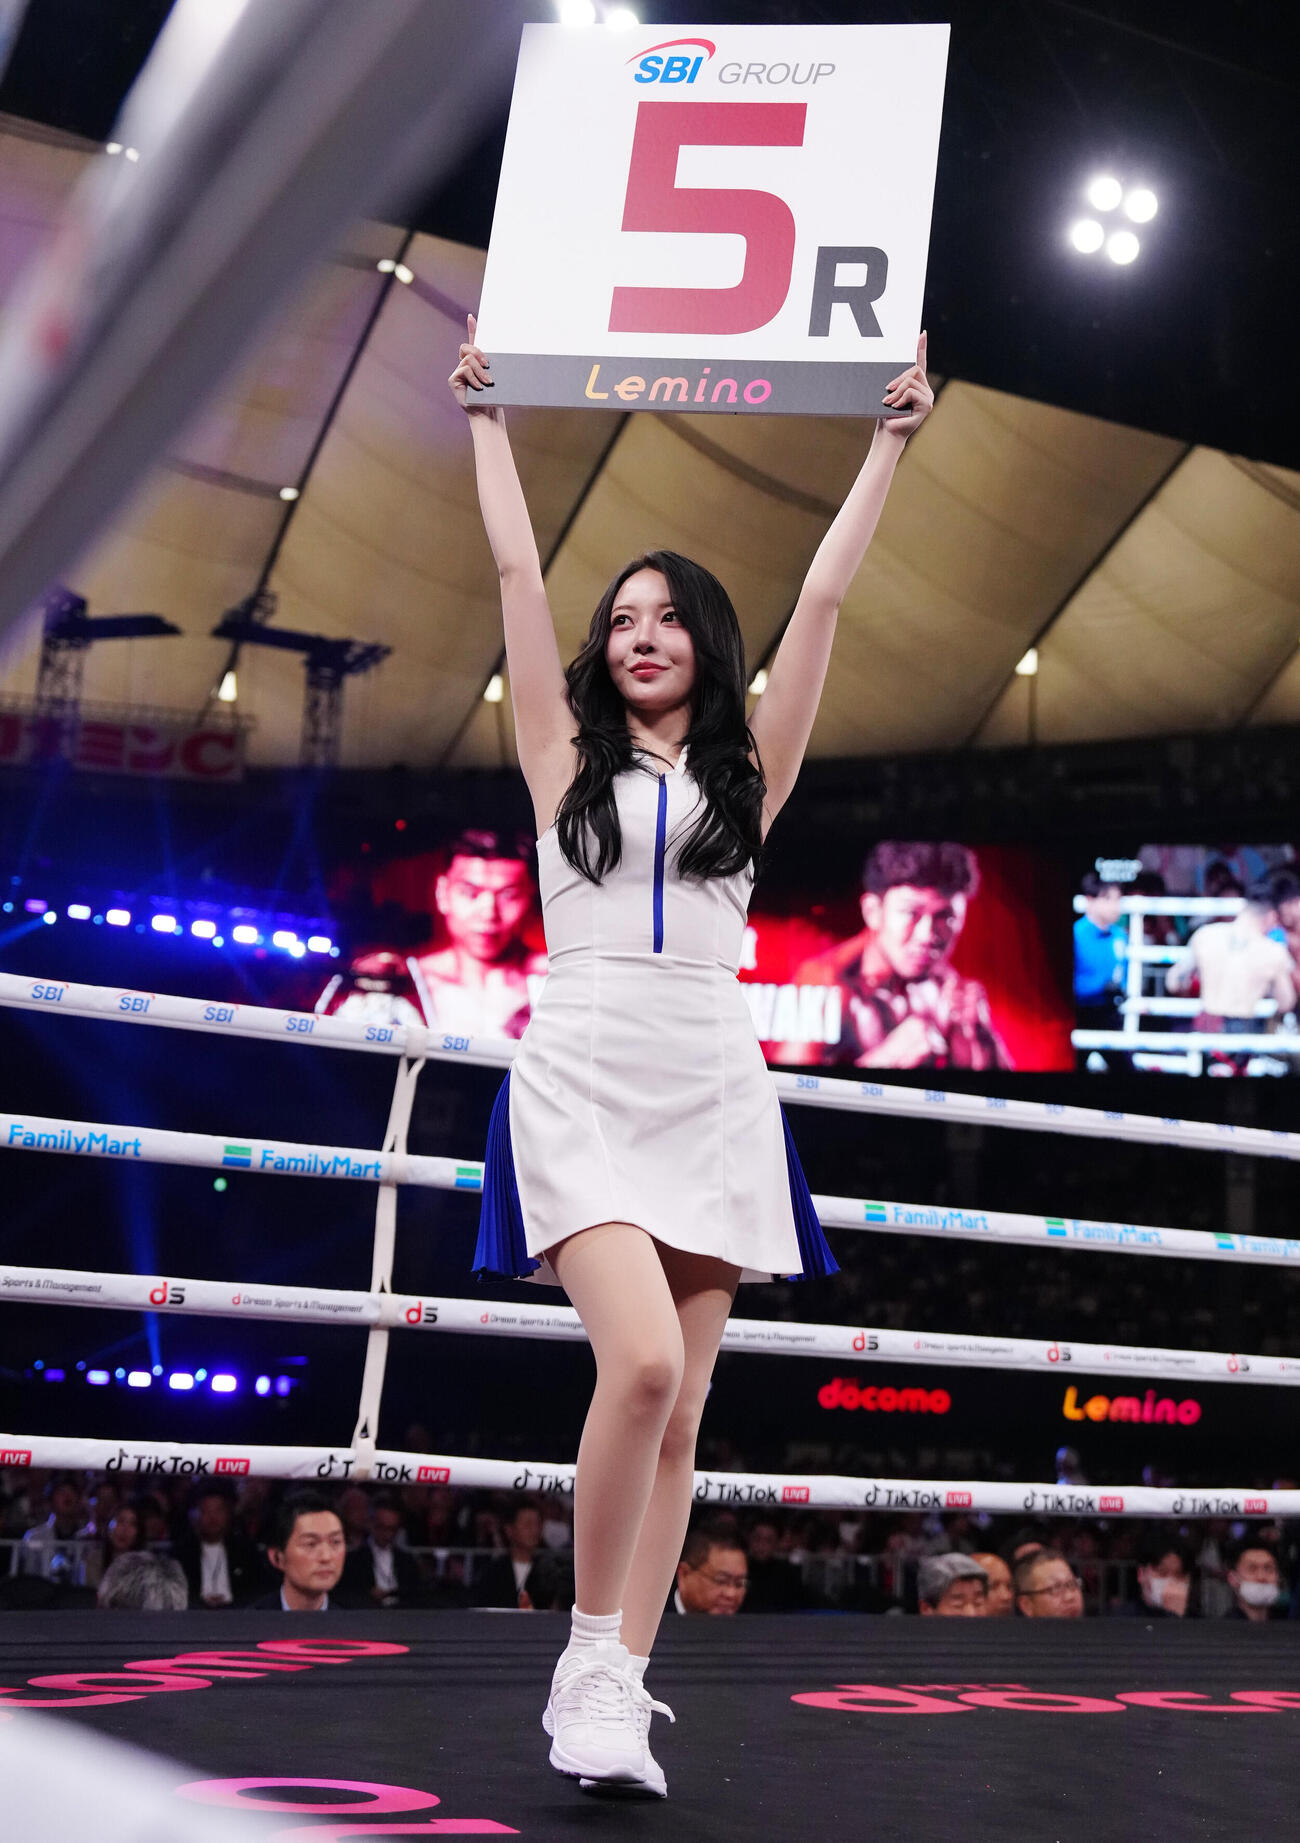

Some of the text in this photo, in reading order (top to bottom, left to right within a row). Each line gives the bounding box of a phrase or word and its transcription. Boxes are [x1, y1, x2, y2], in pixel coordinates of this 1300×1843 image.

[633, 55, 836, 84] SBI GROUP
[607, 100, 889, 338] 5 R
[584, 364, 772, 404] Lemino
[31, 984, 64, 1001] SBI
[119, 997, 150, 1013] SBI
[203, 1007, 234, 1023] SBI
[286, 1017, 315, 1033] SBI
[365, 1027, 393, 1043] SBI
[442, 1036, 469, 1051] SBI
[8, 1124, 141, 1157] FamilyMart
[260, 1150, 382, 1178] FamilyMart
[893, 1206, 989, 1231] FamilyMart
[133, 1456, 247, 1474] TikTok LIVE
[342, 1460, 448, 1482] TTok LIVE
[717, 1483, 808, 1501] TikTok LIVE
[885, 1490, 970, 1507] TikTok LIVE
[1042, 1495, 1099, 1512] TikTok
